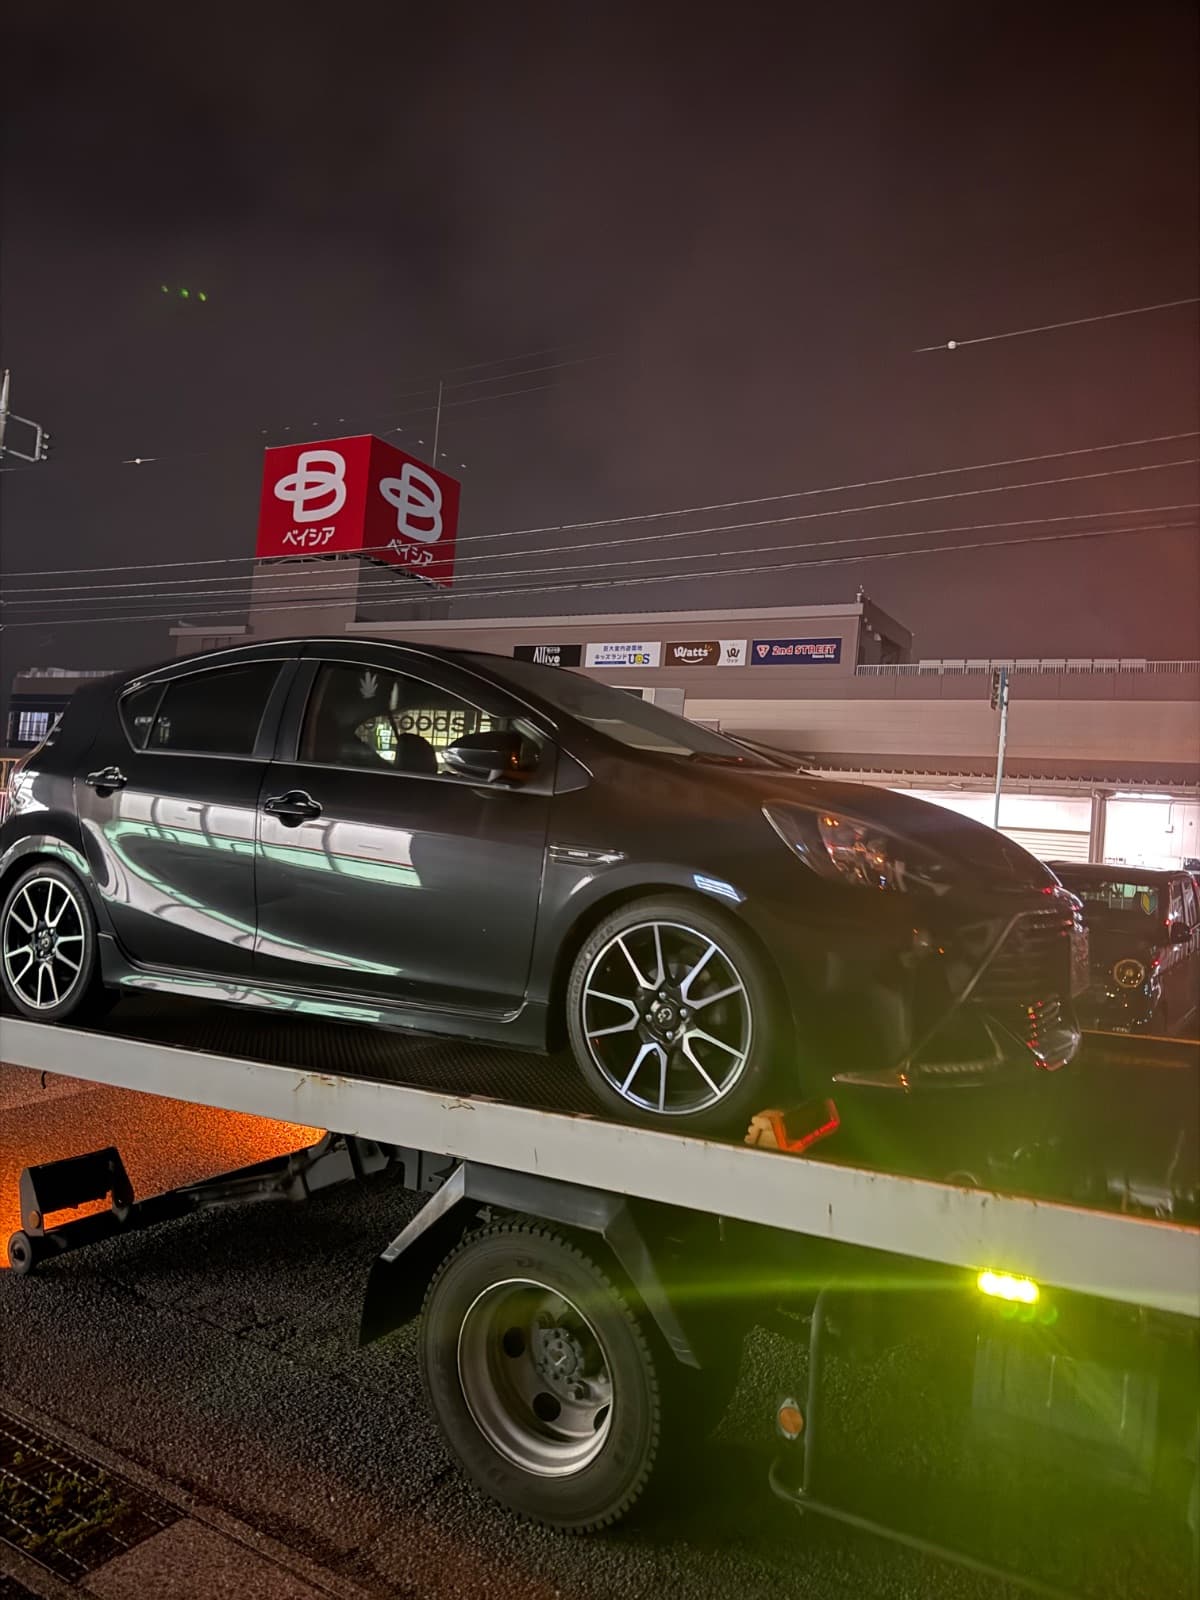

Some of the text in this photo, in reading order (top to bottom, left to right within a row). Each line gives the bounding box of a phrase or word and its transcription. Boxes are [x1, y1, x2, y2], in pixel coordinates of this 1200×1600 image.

[282, 526, 336, 547] ベイシア
[386, 538, 434, 567] ベイシア
[673, 645, 709, 658] Watts
[772, 644, 837, 656] 2nd STREET
